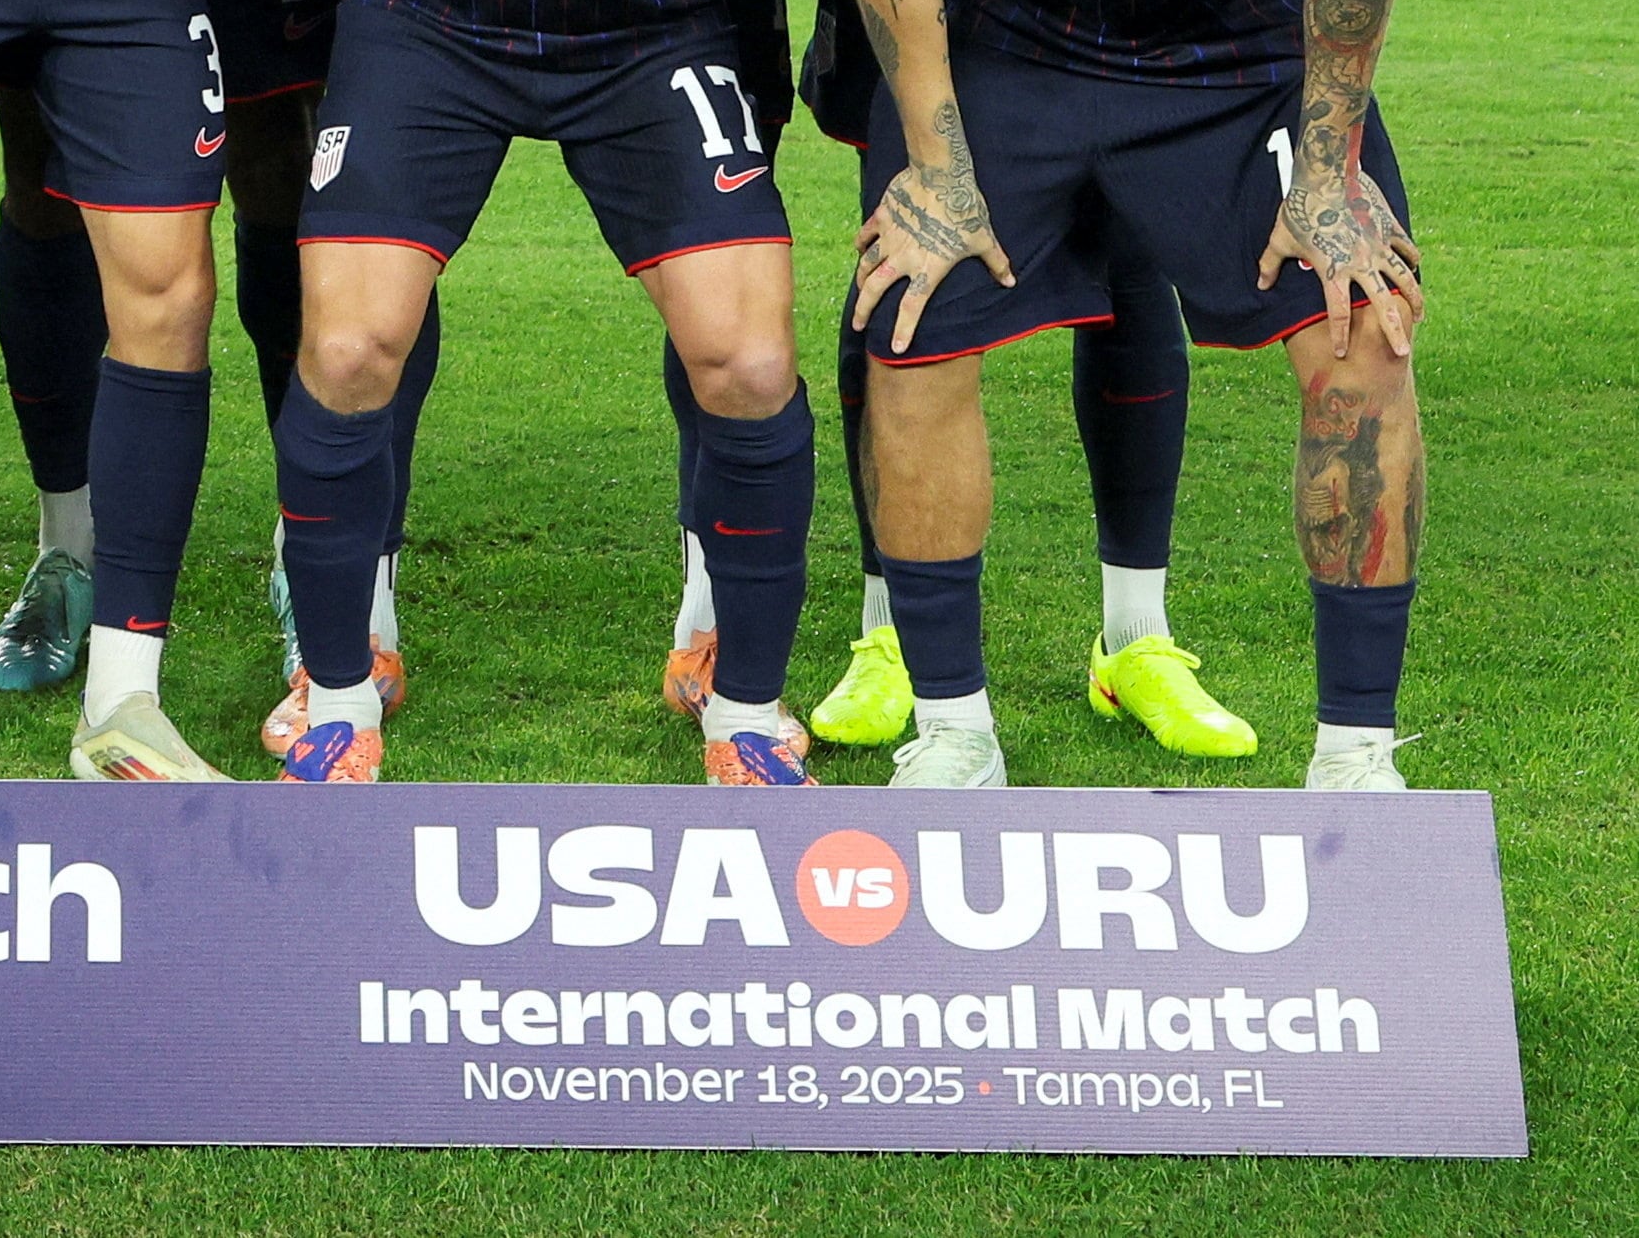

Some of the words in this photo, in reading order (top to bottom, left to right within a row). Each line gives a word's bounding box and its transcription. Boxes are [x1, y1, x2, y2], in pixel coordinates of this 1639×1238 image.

[188, 14, 224, 113] 3
[670, 65, 763, 159] 17
[413, 825, 791, 947] USA
[917, 830, 1310, 953] URU
[359, 979, 1038, 1049] International
[1058, 987, 1380, 1053] Match
[464, 1062, 744, 1103] November
[757, 1064, 829, 1109] 18,
[840, 1065, 964, 1105] 2025
[1003, 1067, 1212, 1114] Tampa,
[1225, 1070, 1284, 1109] FL
